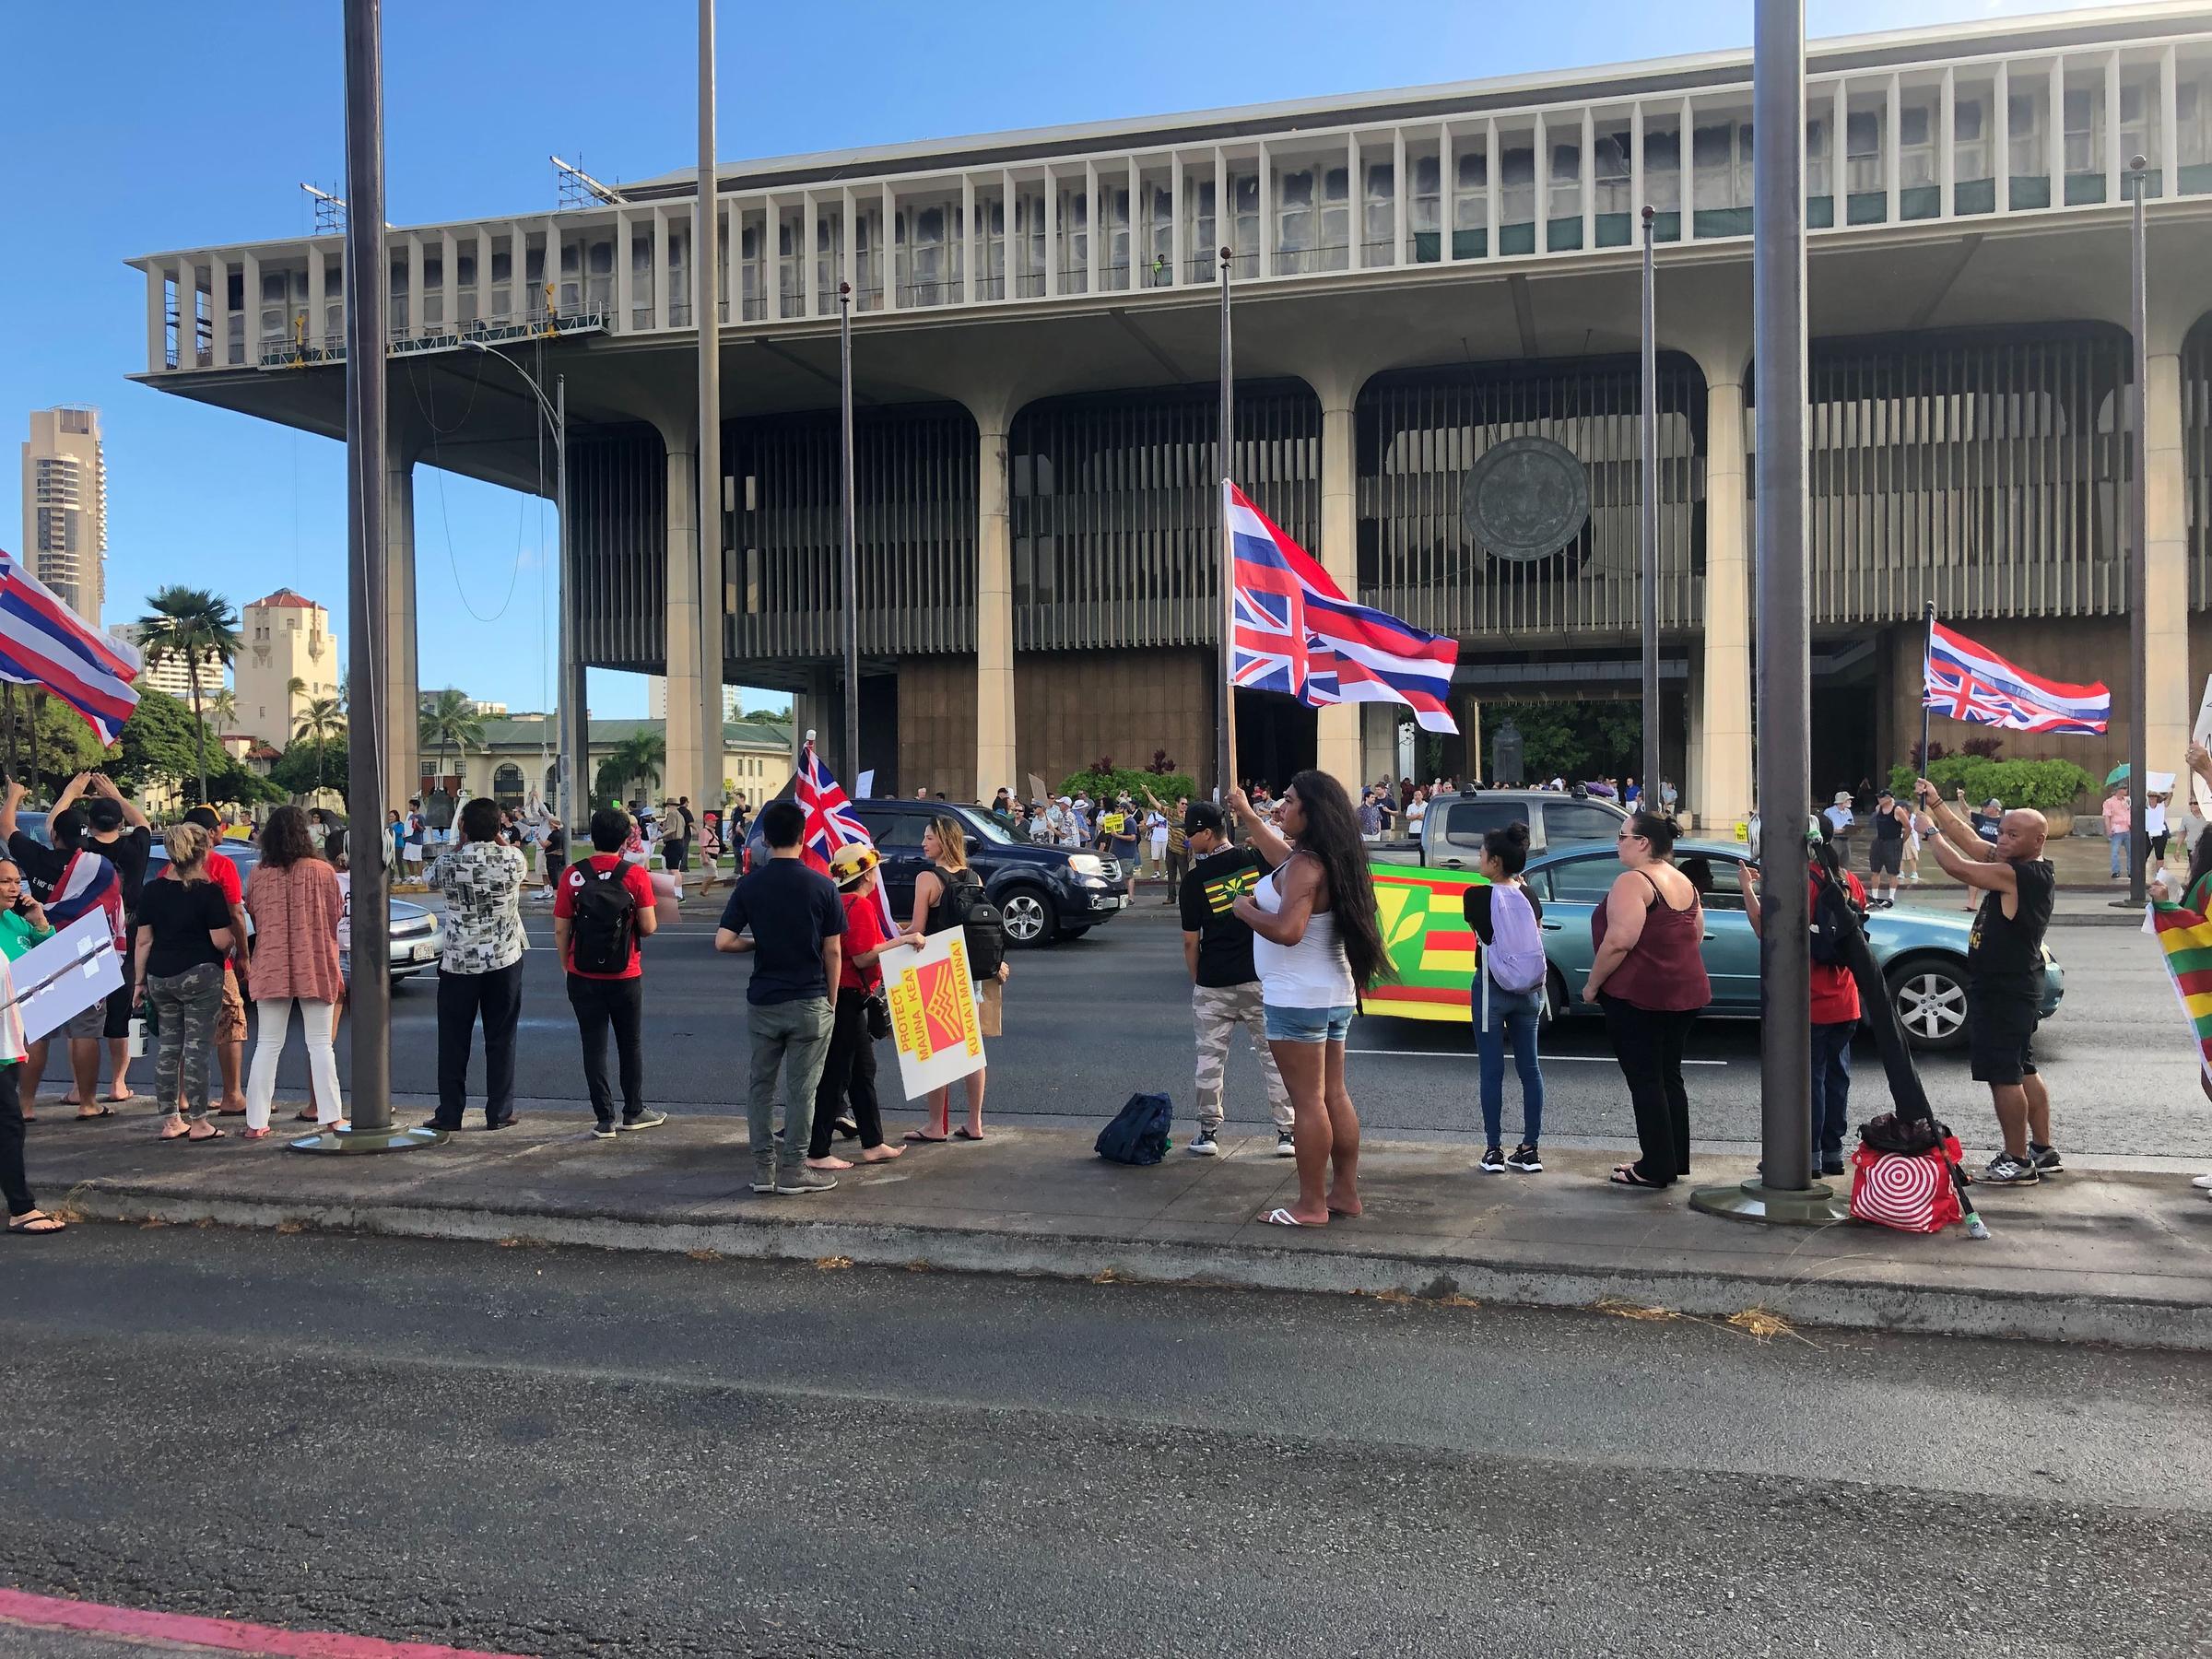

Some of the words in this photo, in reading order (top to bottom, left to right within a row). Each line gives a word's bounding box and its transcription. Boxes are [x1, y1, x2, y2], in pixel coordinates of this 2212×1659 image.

[903, 968, 918, 1003] KEA!
[950, 941, 970, 999] MAUNA!
[891, 988, 912, 1053] PROTECT
[912, 1010, 930, 1062] MAUNA
[968, 1036, 980, 1057] KU
